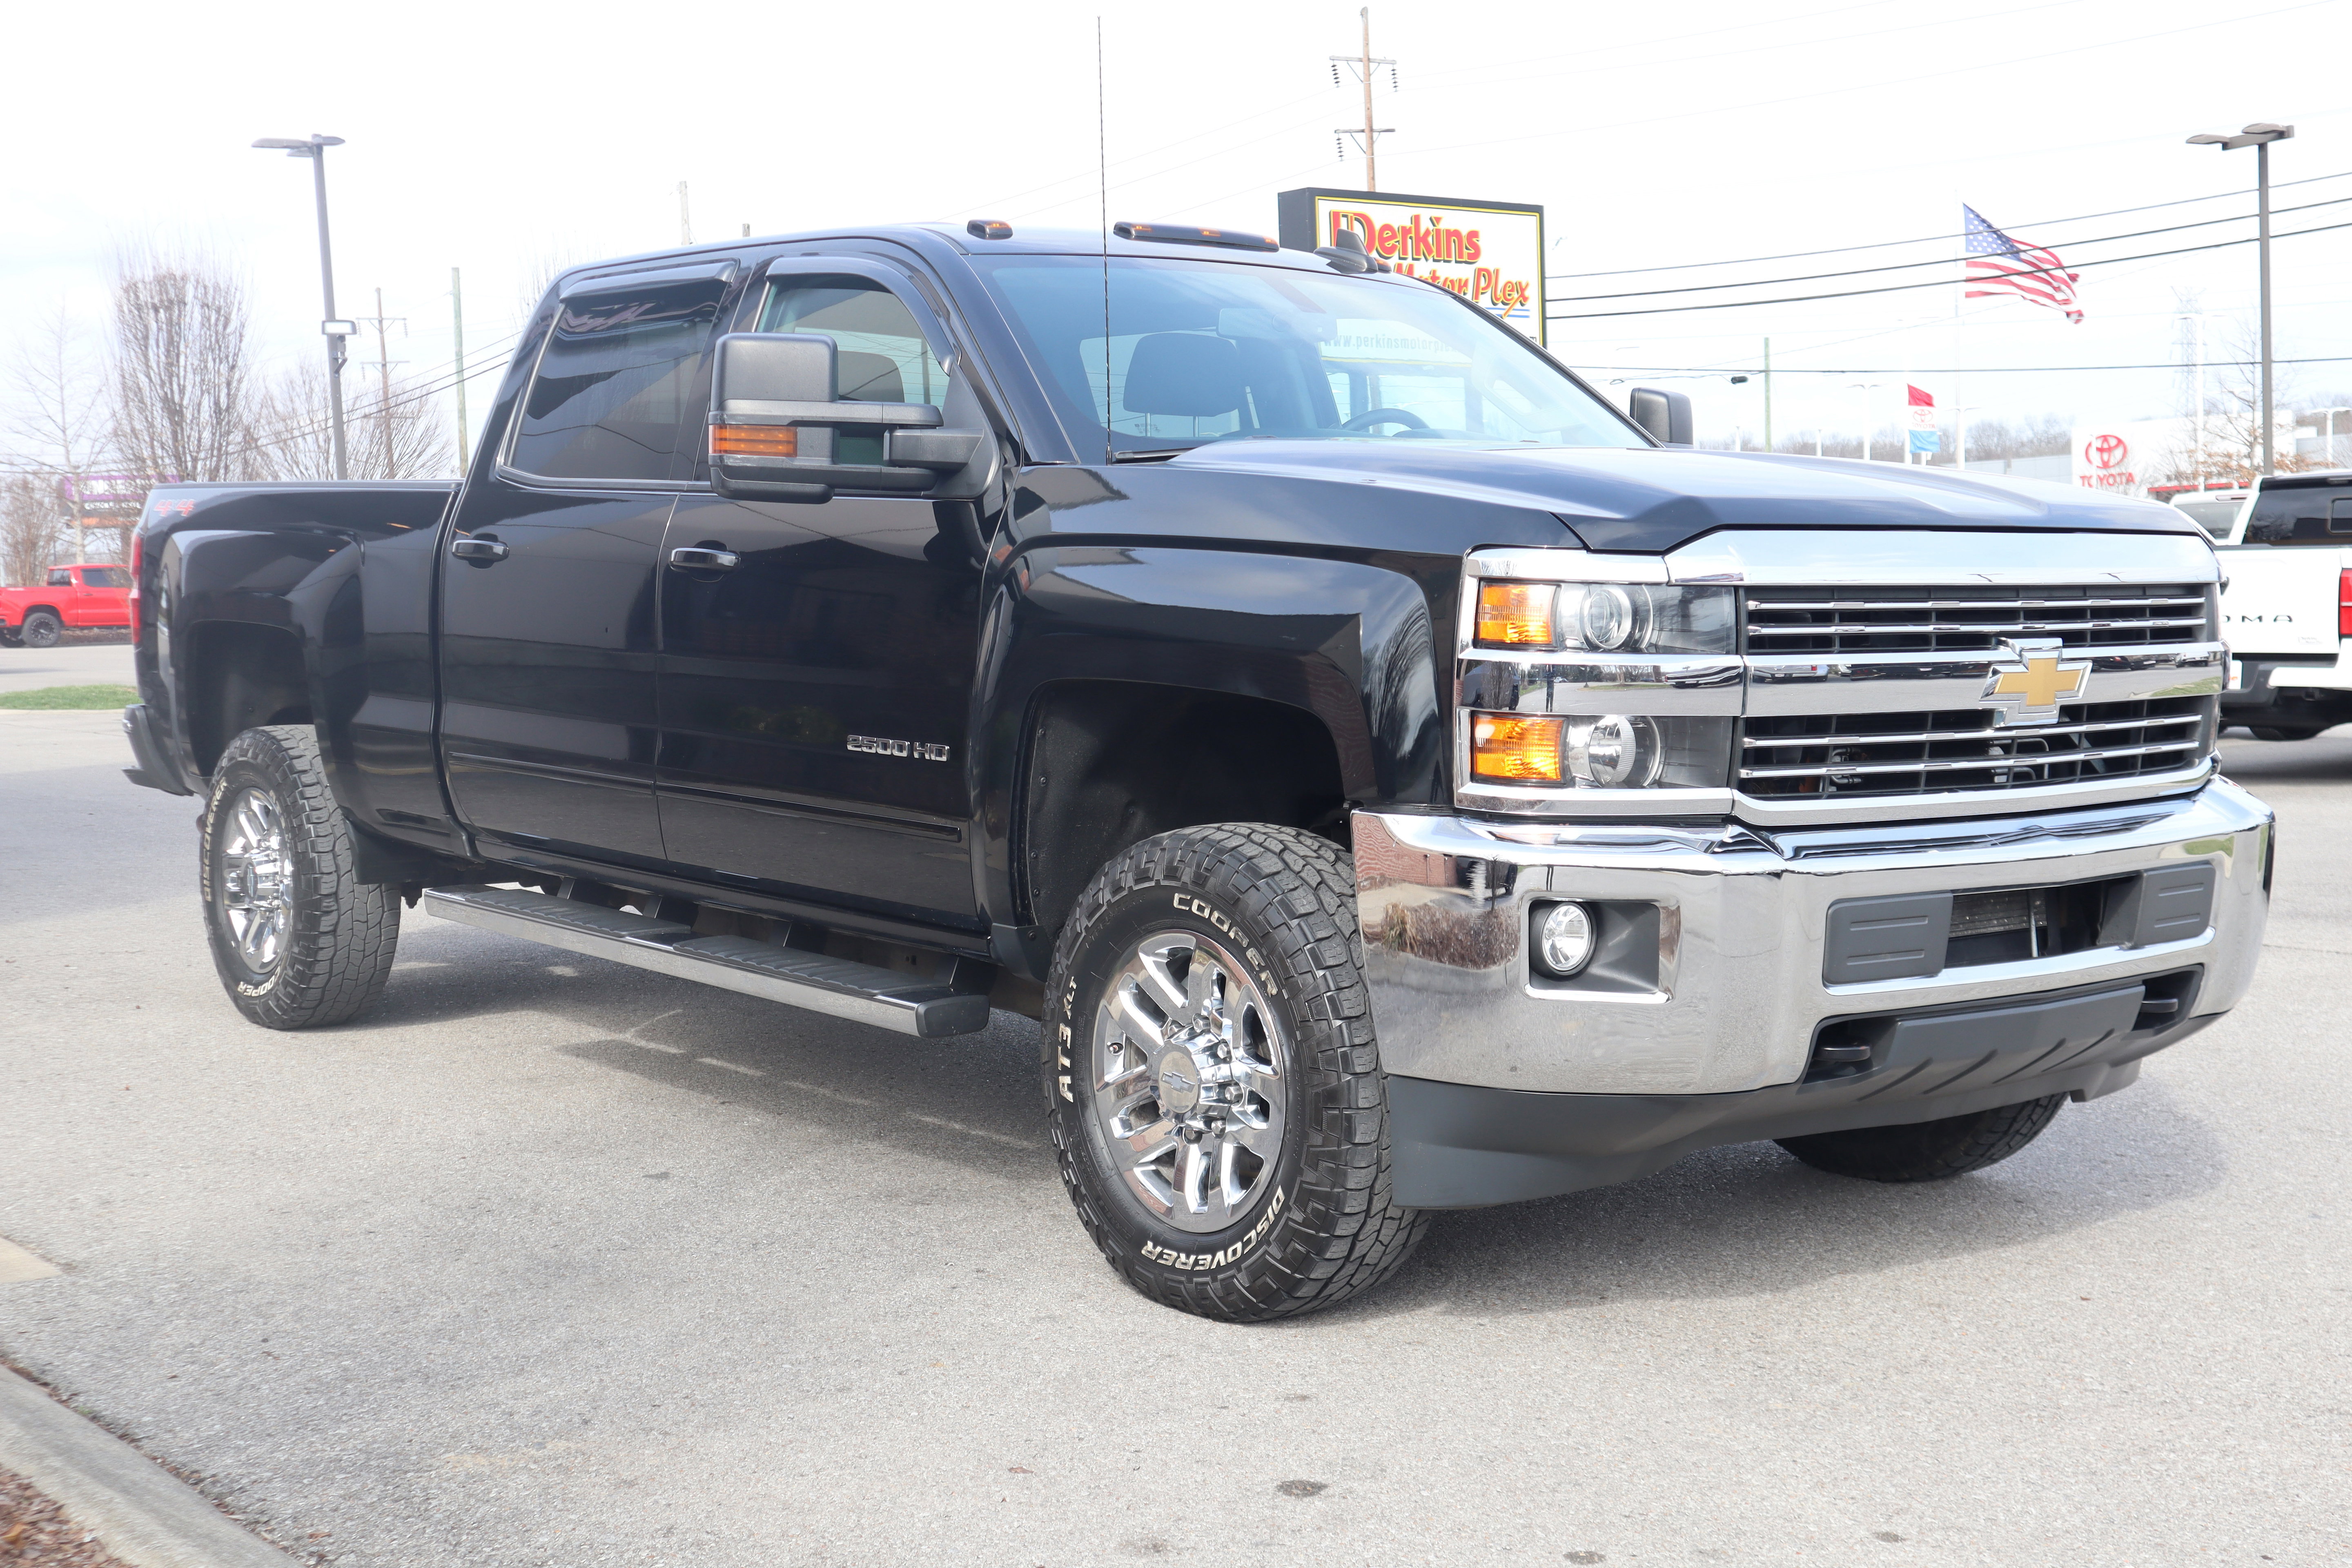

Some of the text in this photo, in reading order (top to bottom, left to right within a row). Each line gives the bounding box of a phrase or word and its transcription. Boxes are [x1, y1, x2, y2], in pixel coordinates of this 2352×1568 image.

[1472, 267, 1530, 316] Plex
[846, 735, 950, 762] 2500 HD
[203, 776, 227, 902] DISCOVERER
[1173, 893, 1278, 998] COOPER
[237, 965, 281, 997] COOPER
[1063, 976, 1077, 1020] XLT
[1141, 1185, 1285, 1271] DISCOVERER
